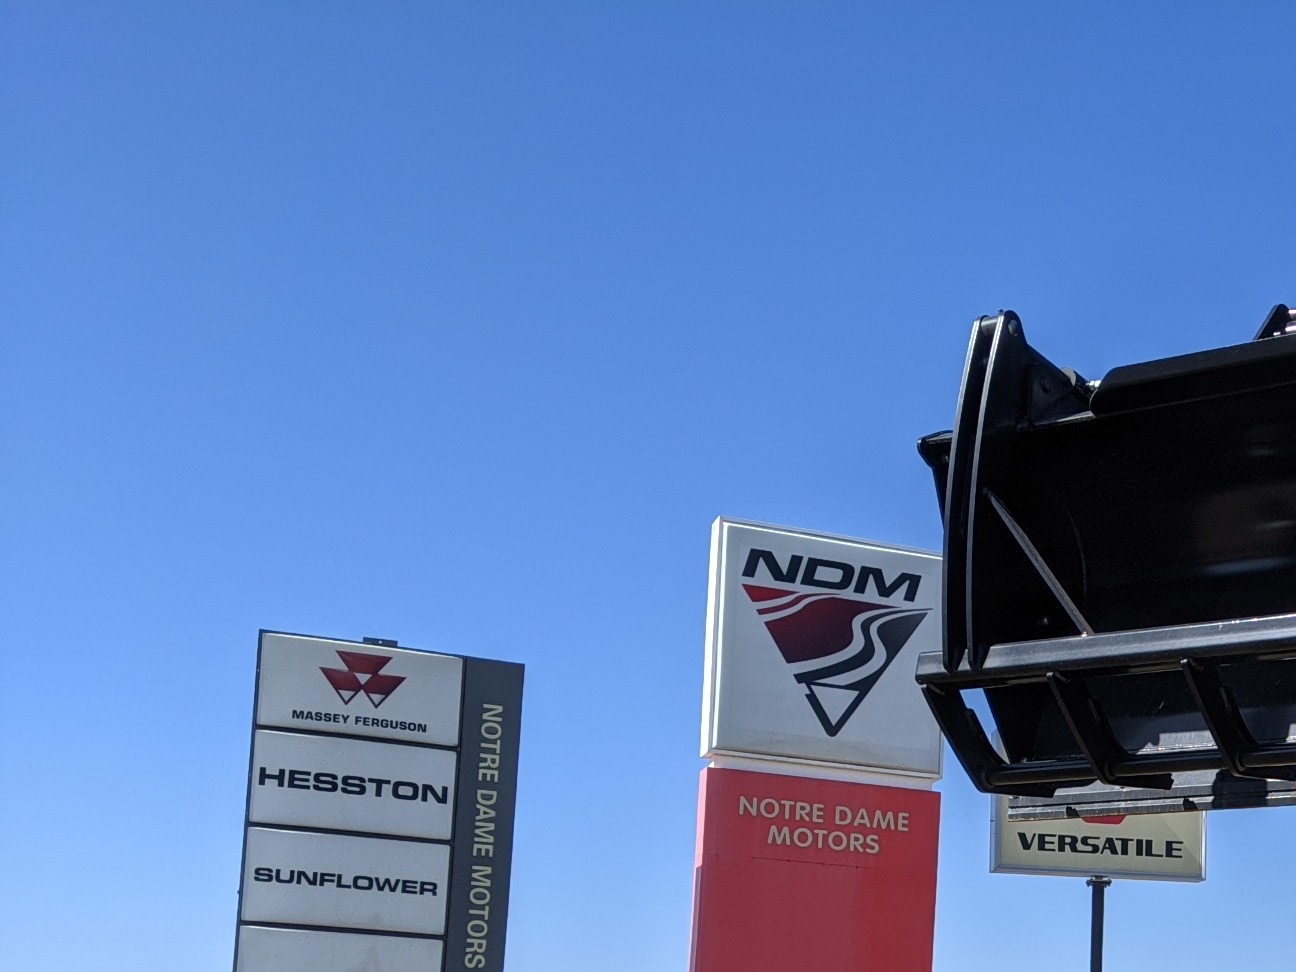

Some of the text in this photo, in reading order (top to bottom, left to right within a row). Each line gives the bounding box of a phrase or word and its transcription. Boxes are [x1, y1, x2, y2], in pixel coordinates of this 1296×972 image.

[742, 548, 922, 602] NDM
[291, 709, 427, 733] MASSEY FERGUSON
[477, 703, 503, 783] NOTRE
[258, 766, 448, 804] HESSTON
[472, 790, 498, 858] DAME
[739, 796, 909, 832] NOTRE DAME
[767, 825, 880, 854] MOTORS
[1017, 832, 1184, 858] VERSATILE
[254, 867, 438, 896] SUNFLOWER
[464, 865, 492, 969] MOTORS
